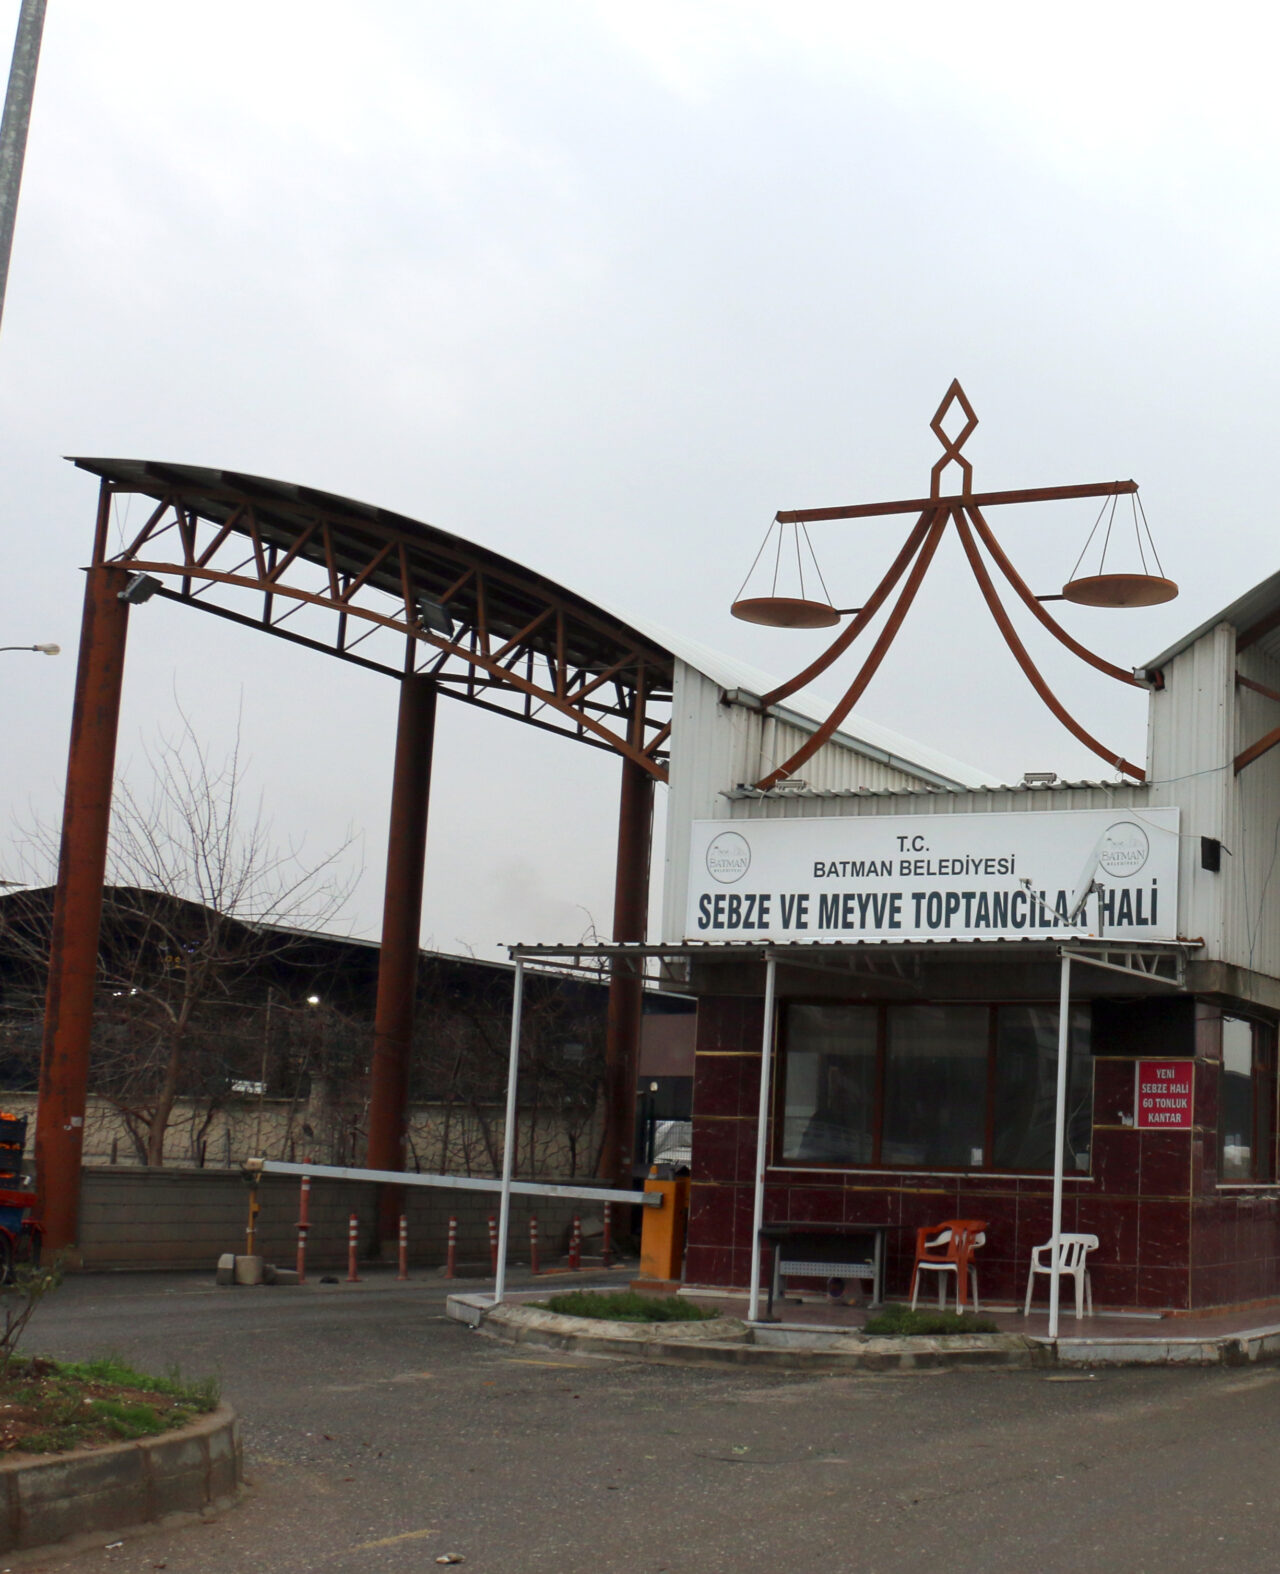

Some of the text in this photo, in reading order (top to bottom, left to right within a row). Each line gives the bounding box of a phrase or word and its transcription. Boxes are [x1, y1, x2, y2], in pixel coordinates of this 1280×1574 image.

[896, 835, 930, 853] T.C.
[813, 853, 1015, 878] BATMAN BELEDİYESİ
[697, 892, 772, 931] SEBZE
[779, 893, 810, 930] VE
[818, 892, 903, 930] MEYVE
[1103, 878, 1158, 927] HALİ
[1156, 1067, 1175, 1078] YENİ
[1142, 1082, 1189, 1093] SEBZE HALİ
[1142, 1098, 1187, 1108] 60 TONLUK
[1148, 1113, 1181, 1122] KANTAR
